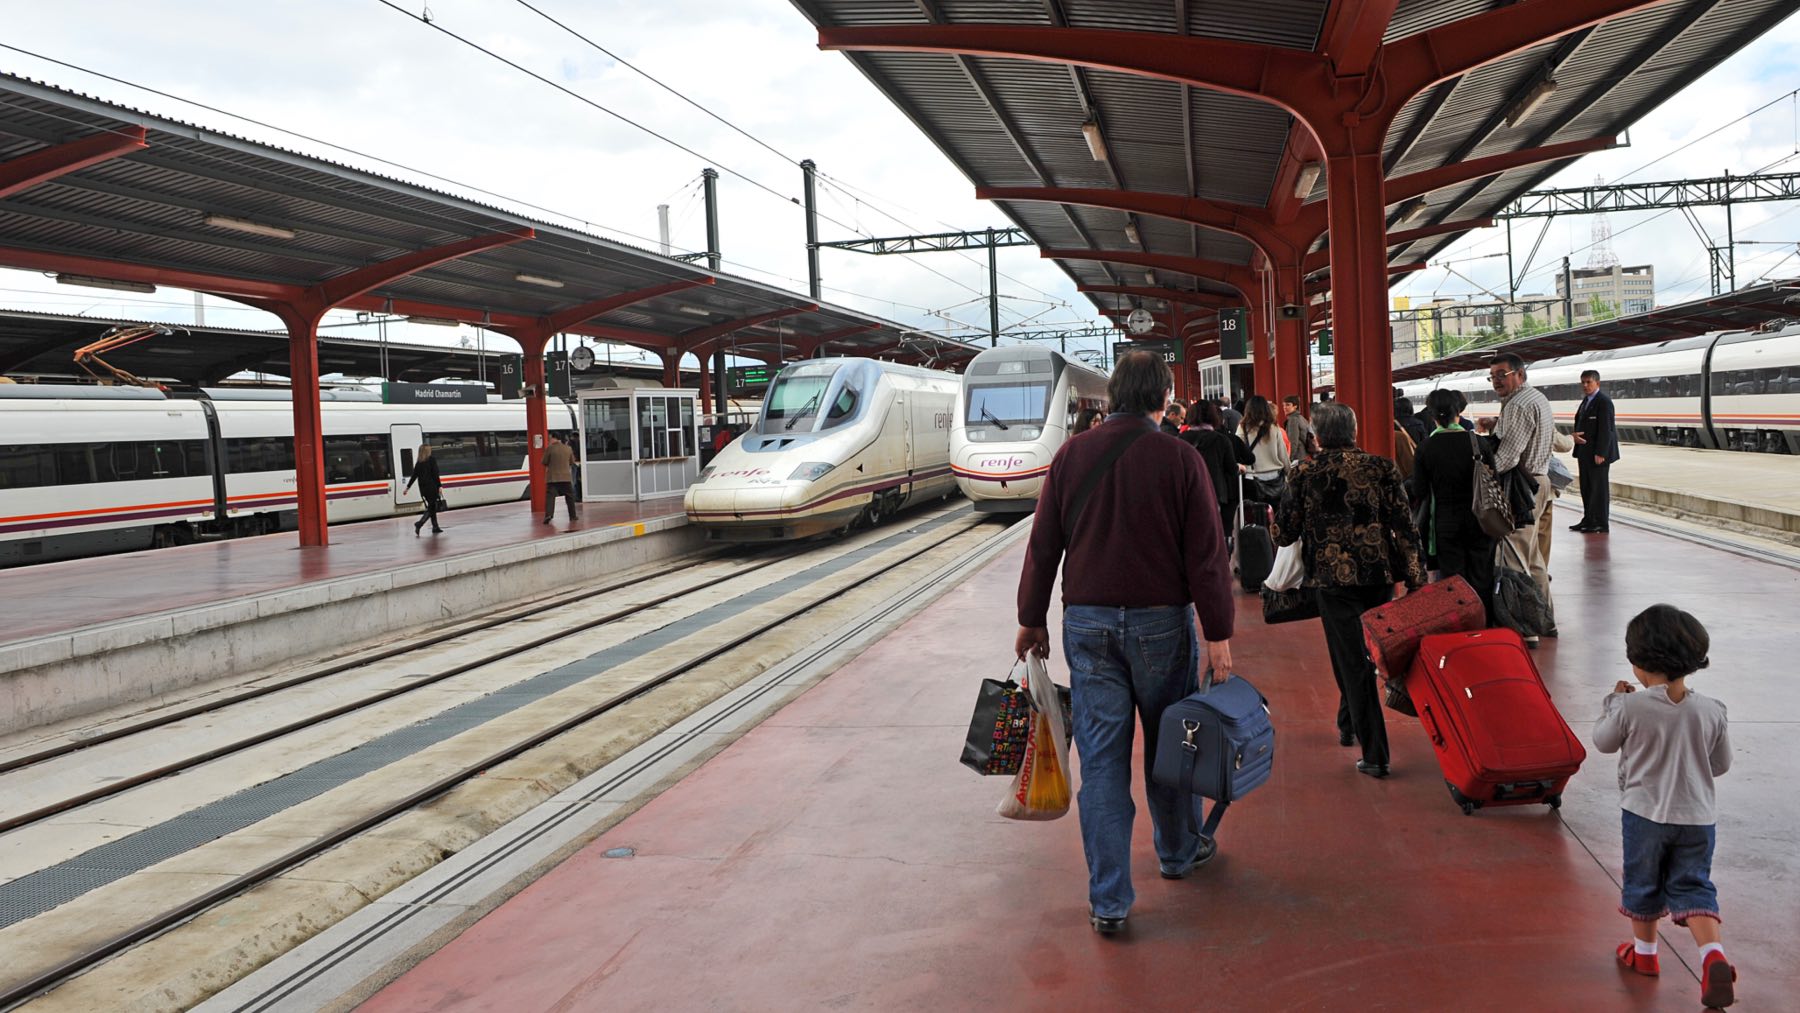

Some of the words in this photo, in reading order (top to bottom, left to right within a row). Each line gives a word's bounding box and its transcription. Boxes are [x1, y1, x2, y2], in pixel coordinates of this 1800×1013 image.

[1222, 319, 1237, 331] 18
[1163, 352, 1176, 362] 18
[502, 363, 514, 375] 16
[555, 360, 566, 371] 17
[736, 378, 745, 388] 17
[415, 389, 434, 398] Madrid
[980, 456, 1023, 471] renfe
[710, 468, 770, 479] renfe
